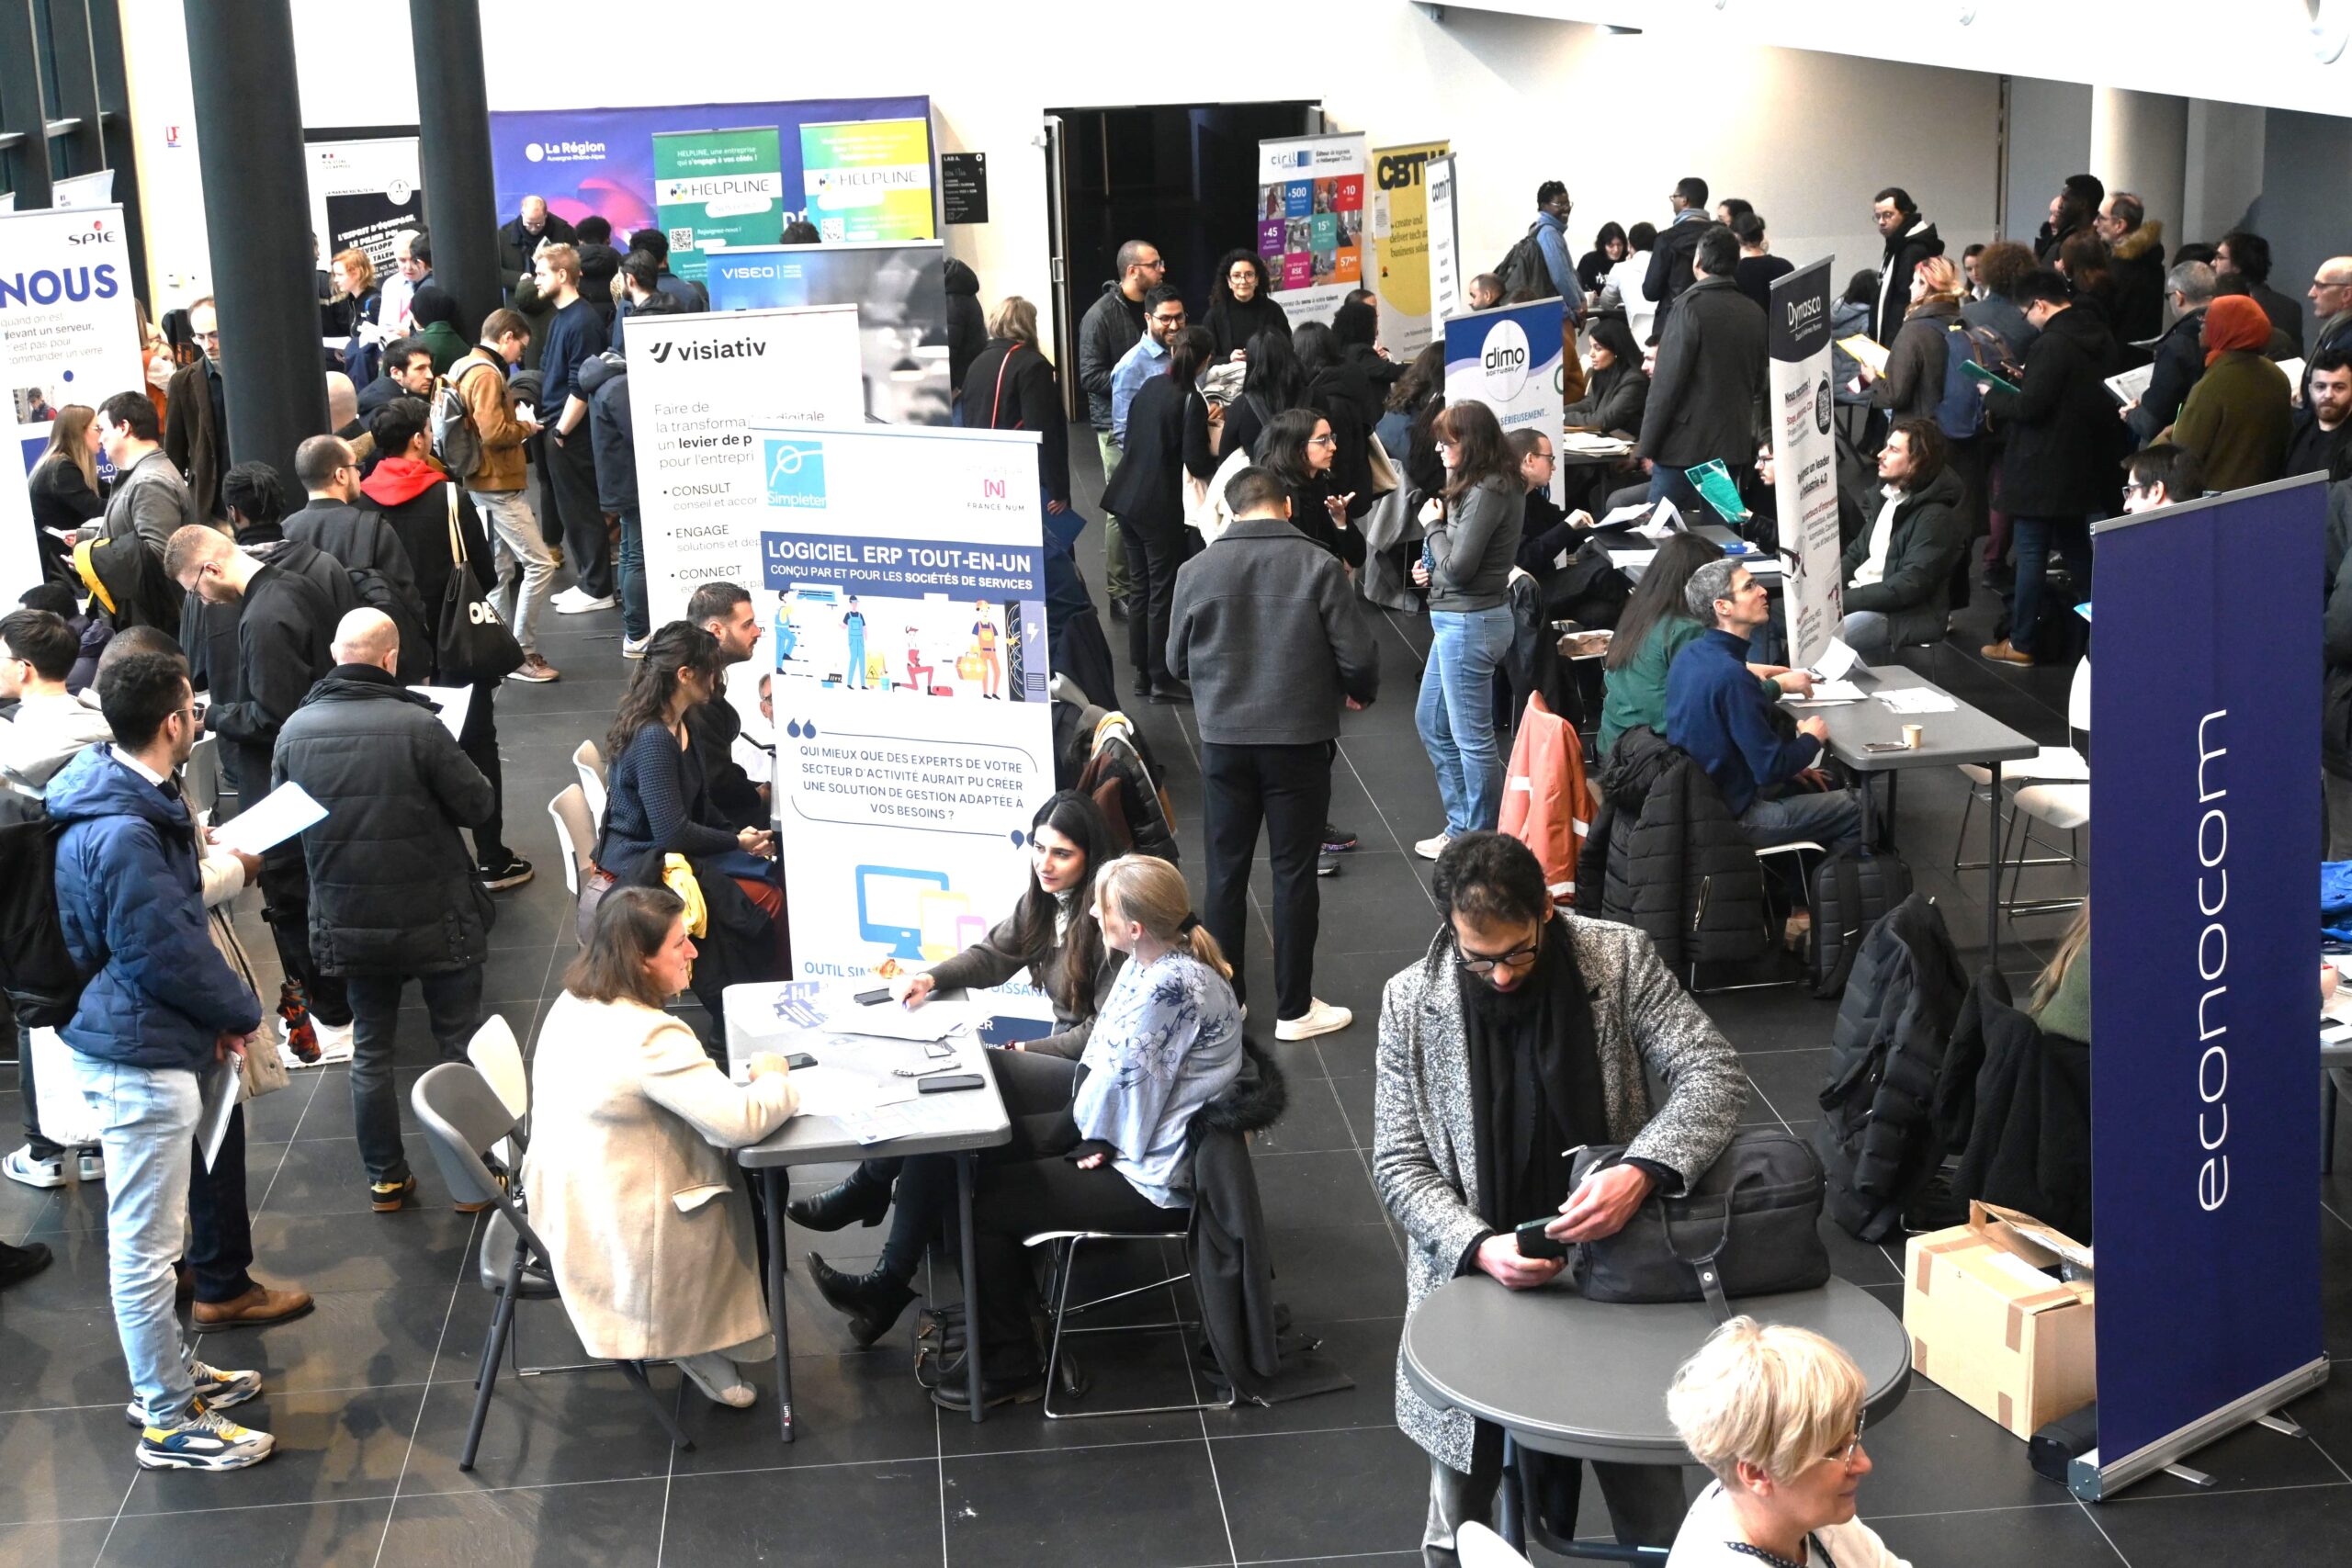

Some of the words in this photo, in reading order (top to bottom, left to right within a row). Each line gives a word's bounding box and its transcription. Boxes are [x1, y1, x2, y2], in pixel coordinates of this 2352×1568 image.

[545, 142, 560, 154] La
[561, 141, 605, 154] Région
[677, 159, 687, 167] qui
[1271, 152, 1297, 165] ciril
[1377, 150, 1445, 190] CBT
[840, 170, 918, 186] HELPLINE
[691, 179, 769, 196] HELPLINE
[1288, 186, 1306, 198] +500
[1342, 185, 1356, 196] +10
[68, 227, 116, 245] SPIE
[1263, 227, 1278, 237] +45
[373, 251, 394, 262] TALEN
[1390, 246, 1415, 257] business
[721, 266, 774, 279] VISEO
[0, 264, 119, 308] NOUS
[1, 314, 31, 327] quand
[33, 314, 46, 324] on
[49, 312, 64, 322] est
[40, 327, 52, 336] un
[30, 340, 47, 351] pas
[51, 338, 71, 348] pour
[80, 345, 104, 355] verre
[677, 336, 766, 361] visiativ
[1486, 346, 1525, 369] dimo
[1486, 367, 1515, 377] SOFTWARE
[654, 403, 688, 415] Faire
[692, 401, 710, 412] de
[656, 422, 669, 433] la
[658, 441, 674, 450] un
[678, 435, 718, 448] levier
[721, 434, 741, 446] de
[660, 457, 691, 470] pour
[695, 450, 754, 467] l'entrepri
[1815, 455, 1829, 469] leader
[672, 482, 731, 497] CONSULT
[673, 502, 711, 511] conseil
[967, 502, 1001, 511] FRANCE
[675, 525, 729, 538] ENGAGE
[677, 541, 725, 552] solutions
[728, 539, 738, 547] et
[768, 540, 858, 563] LOGICIEL
[864, 546, 903, 565] ERP
[908, 548, 1031, 573] TOUT-EN-UN
[679, 565, 742, 580] CONNECT
[771, 564, 808, 577] CONÇU
[810, 567, 831, 579] PAR
[834, 568, 848, 579] ET
[850, 569, 880, 581] POUR
[883, 571, 902, 582] LES
[905, 570, 959, 586] SOCIÉTÉS
[961, 575, 977, 587] DE
[978, 577, 1033, 591] SERVICES
[800, 745, 820, 757] QUI
[822, 747, 856, 761] MIEUX
[860, 750, 884, 762] QUE
[887, 752, 909, 764] DES
[910, 754, 963, 769] EXPERTS
[966, 758, 980, 770] DE
[984, 760, 1023, 773] VOTRE
[802, 762, 853, 777] SECTEUR
[855, 767, 919, 783] D'ACTIVITÉ
[922, 773, 965, 786] AURAIT
[967, 776, 983, 787] PU
[986, 776, 1023, 791] CRÉER
[803, 781, 826, 792] UNE
[828, 782, 887, 797] SOLUTION
[888, 786, 903, 798] DE
[906, 788, 956, 803] GESTION
[959, 793, 1013, 807] ADAPTÉE
[1015, 795, 1023, 808] À
[870, 803, 895, 815] VOS
[897, 805, 945, 819] BESOINS
[948, 809, 955, 820] ?
[2198, 708, 2229, 1211] econocom
[804, 962, 845, 977] OUTIL
